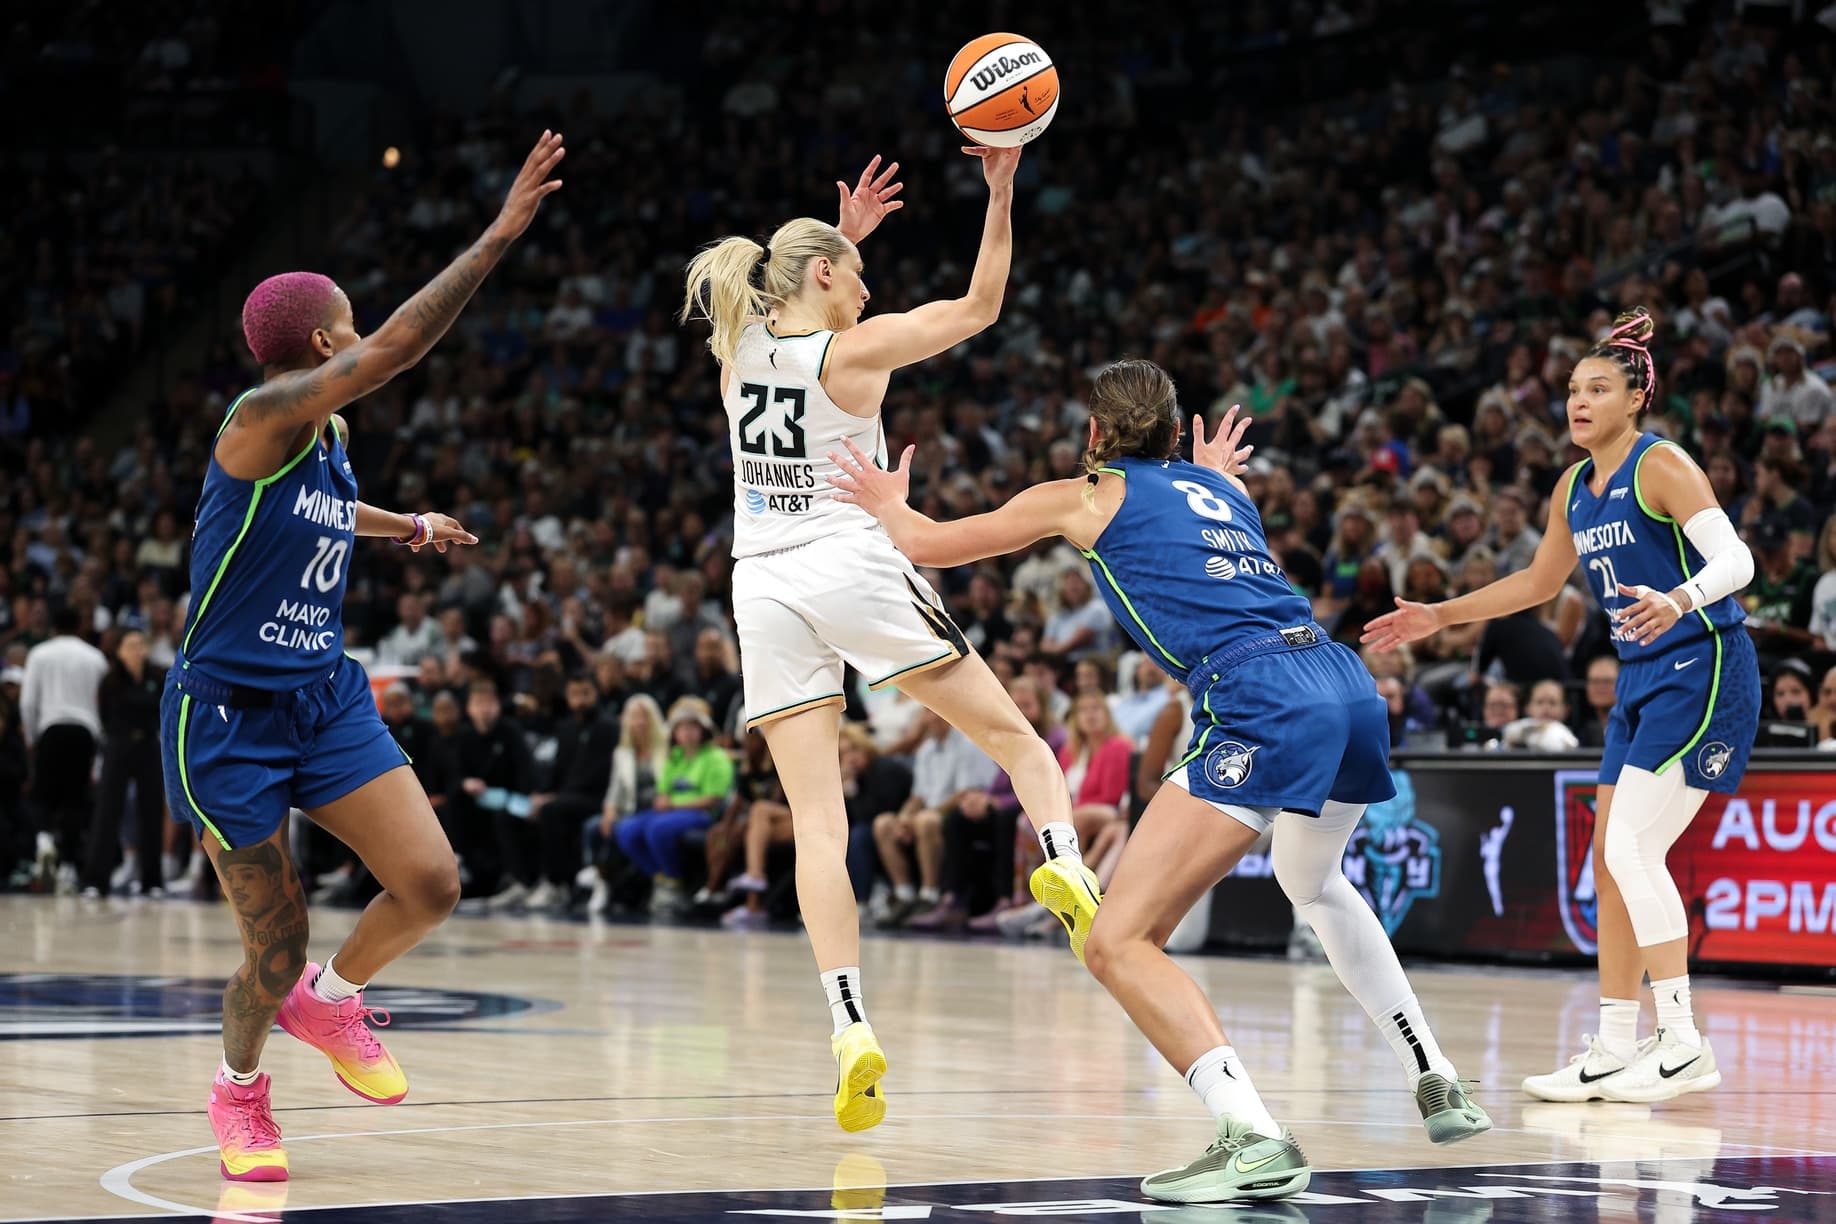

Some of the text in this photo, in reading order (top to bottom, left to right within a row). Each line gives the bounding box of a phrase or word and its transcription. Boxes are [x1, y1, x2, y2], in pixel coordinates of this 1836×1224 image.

[970, 51, 1042, 91] Wilson
[739, 382, 806, 459] 23
[741, 459, 815, 489] JOHANNES
[293, 484, 356, 532] MINNES
[768, 494, 814, 513] AT&T
[1171, 480, 1233, 522] 8
[1573, 520, 1636, 556] NNESOTA
[300, 536, 349, 594] 10
[1589, 555, 1618, 598] 21
[276, 599, 330, 627] MAYO
[258, 622, 335, 651] CLINIC
[1705, 878, 1836, 933] 2PM
